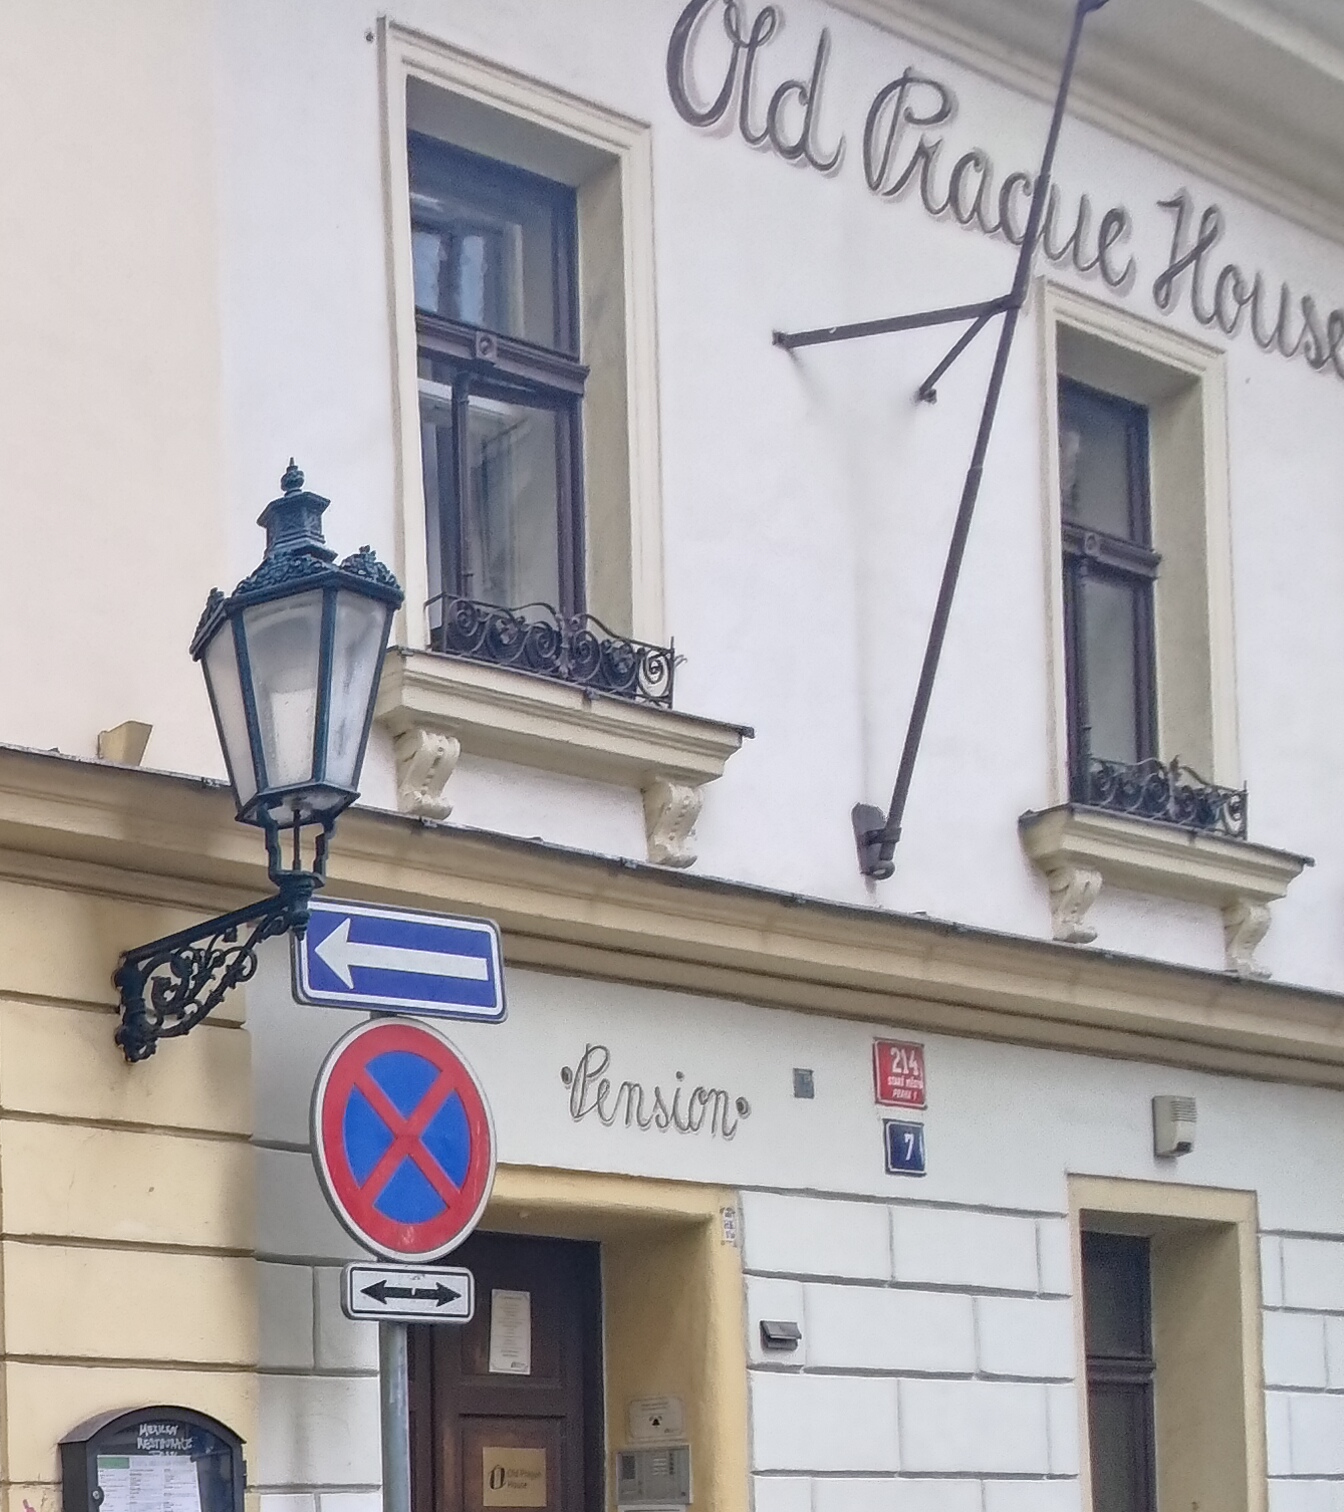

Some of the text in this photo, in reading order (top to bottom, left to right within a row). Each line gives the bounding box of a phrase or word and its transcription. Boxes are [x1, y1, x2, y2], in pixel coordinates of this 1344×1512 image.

[666, 0, 845, 171] Old
[1153, 194, 1344, 381] House
[569, 1043, 738, 1138] Pension
[891, 1047, 919, 1075] 214
[904, 1133, 914, 1161] 7
